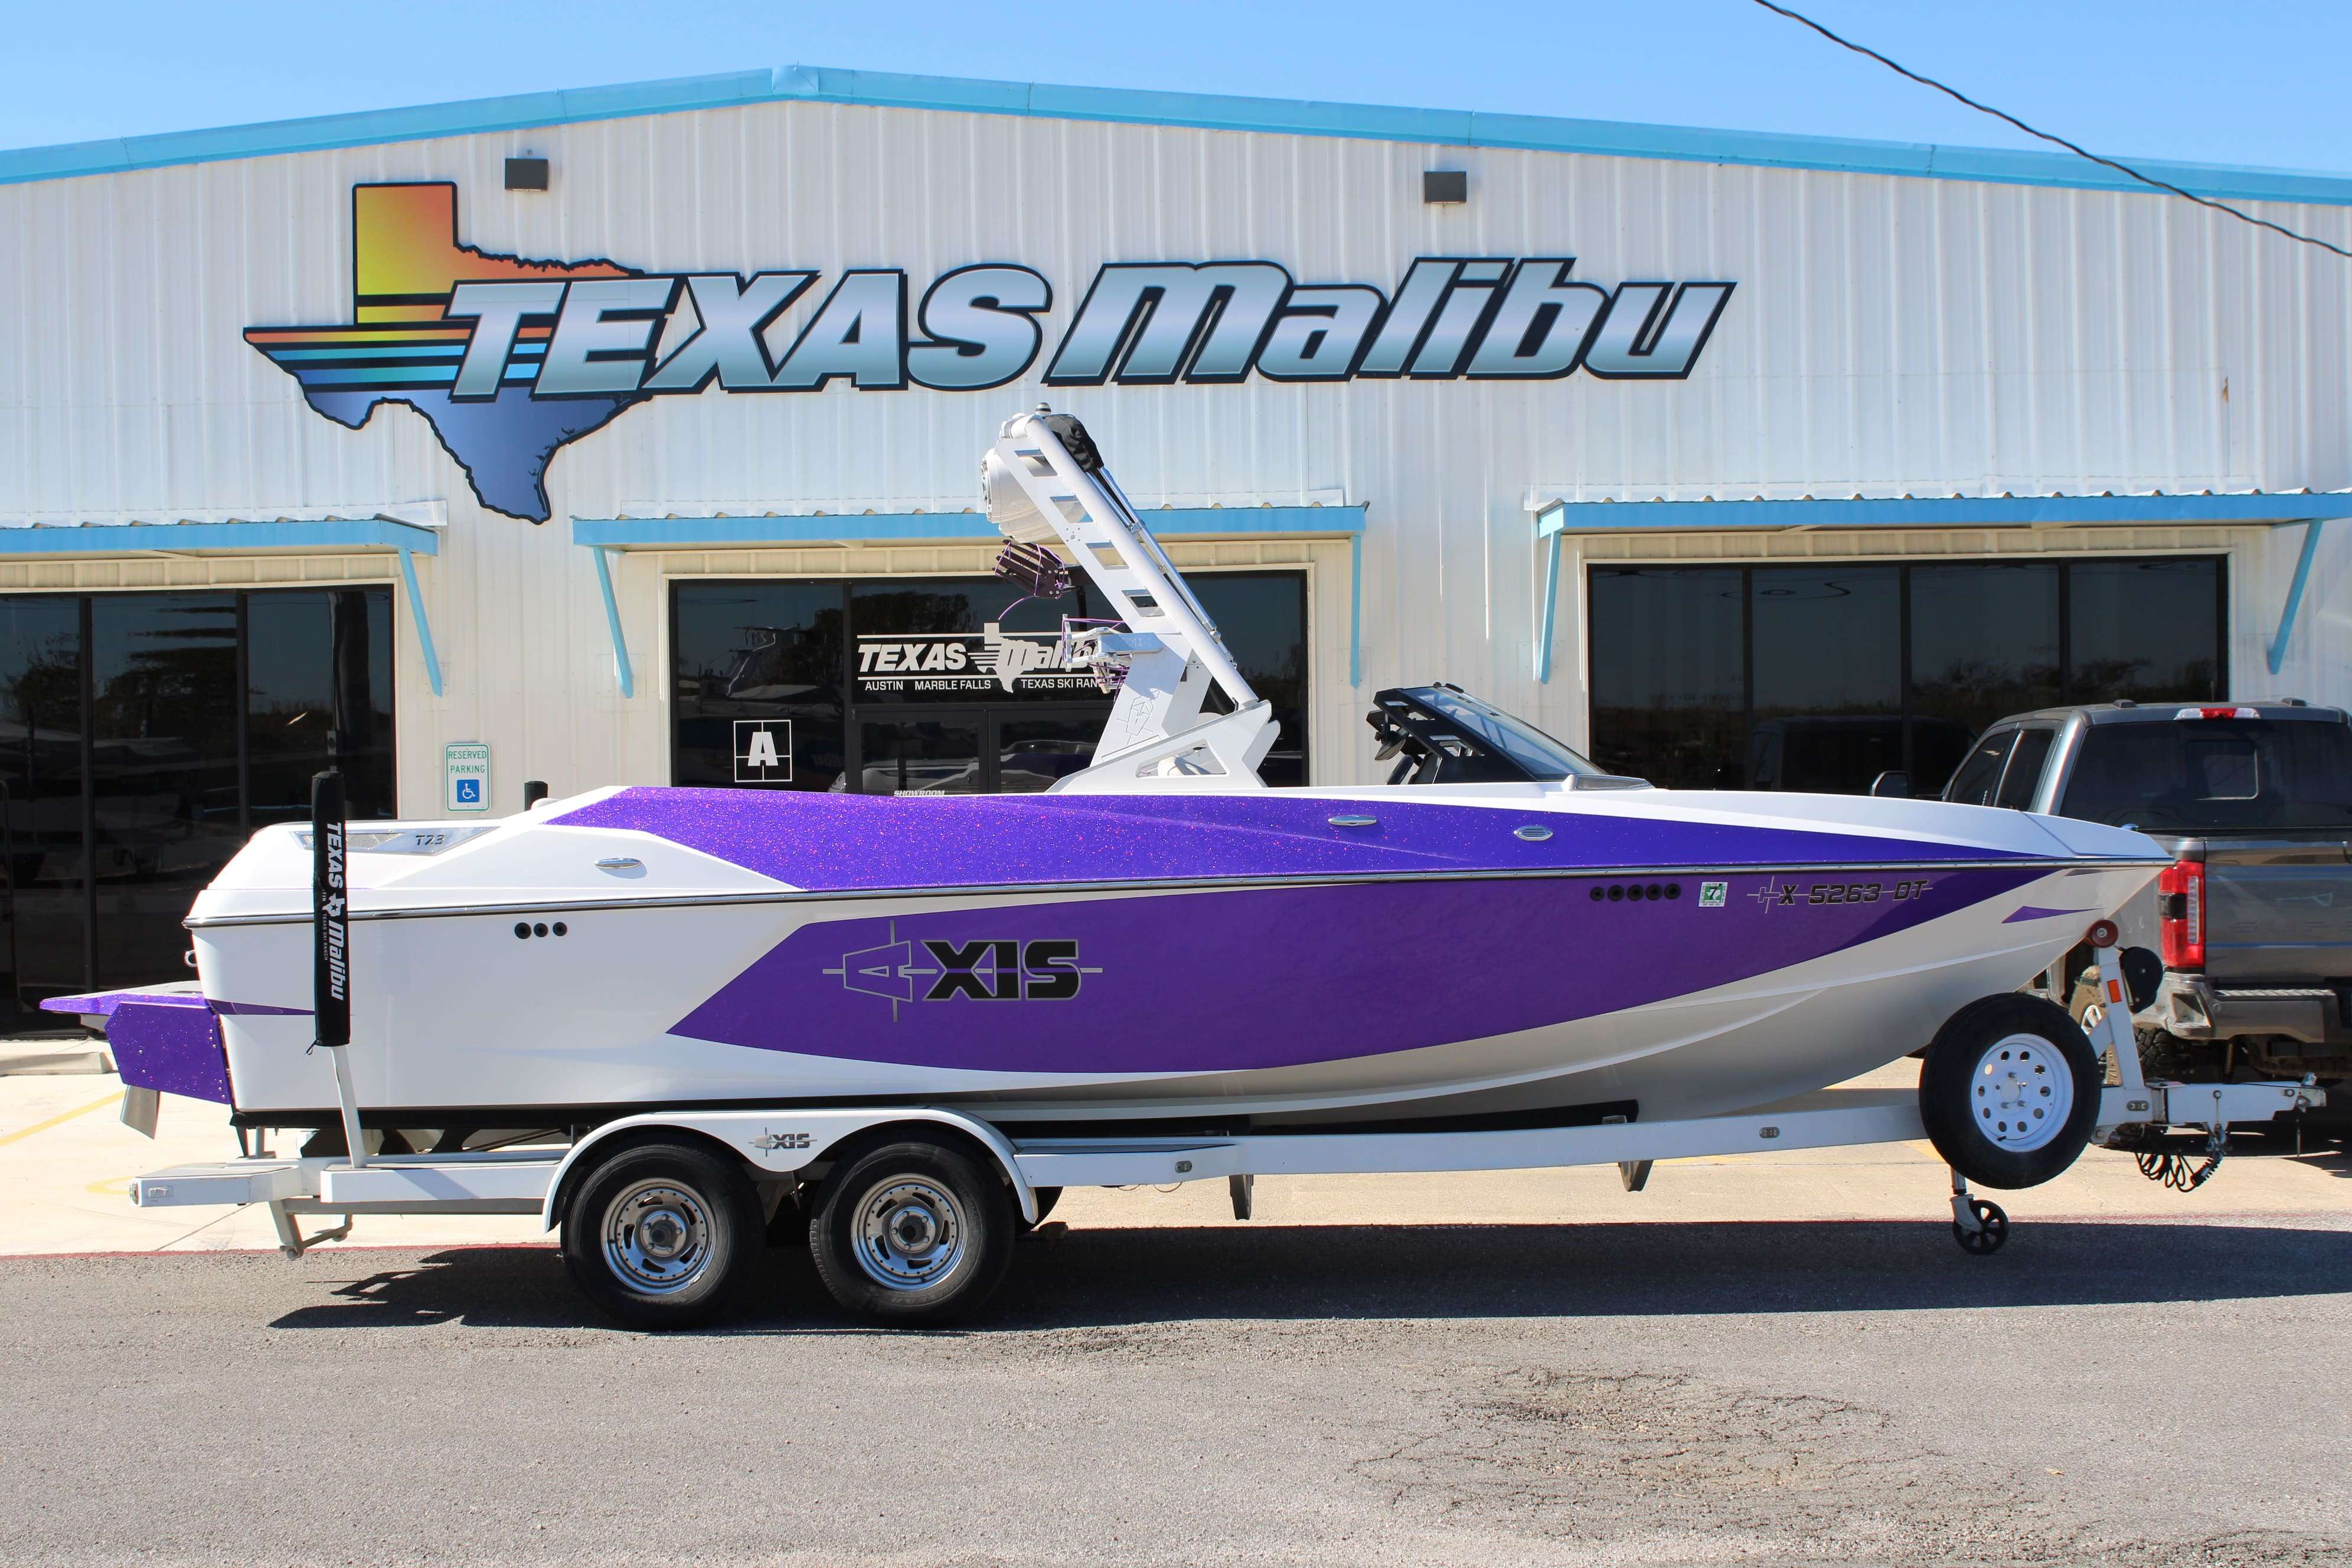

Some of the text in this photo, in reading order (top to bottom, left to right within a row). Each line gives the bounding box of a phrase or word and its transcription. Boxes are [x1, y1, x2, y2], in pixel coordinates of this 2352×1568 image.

[441, 257, 1737, 404] TEXAS Malibu
[857, 642, 967, 672] TEXAS
[865, 680, 904, 691] AUSTIN
[914, 679, 992, 690] MARBLE FALLS
[1021, 678, 1099, 689] TEXAS SKI RAN
[448, 750, 487, 759] RESERVED
[450, 765, 485, 773] PARKING
[416, 834, 445, 845] T23
[1808, 883, 1883, 905] 5263
[327, 822, 346, 1001] TEXAS Malibu
